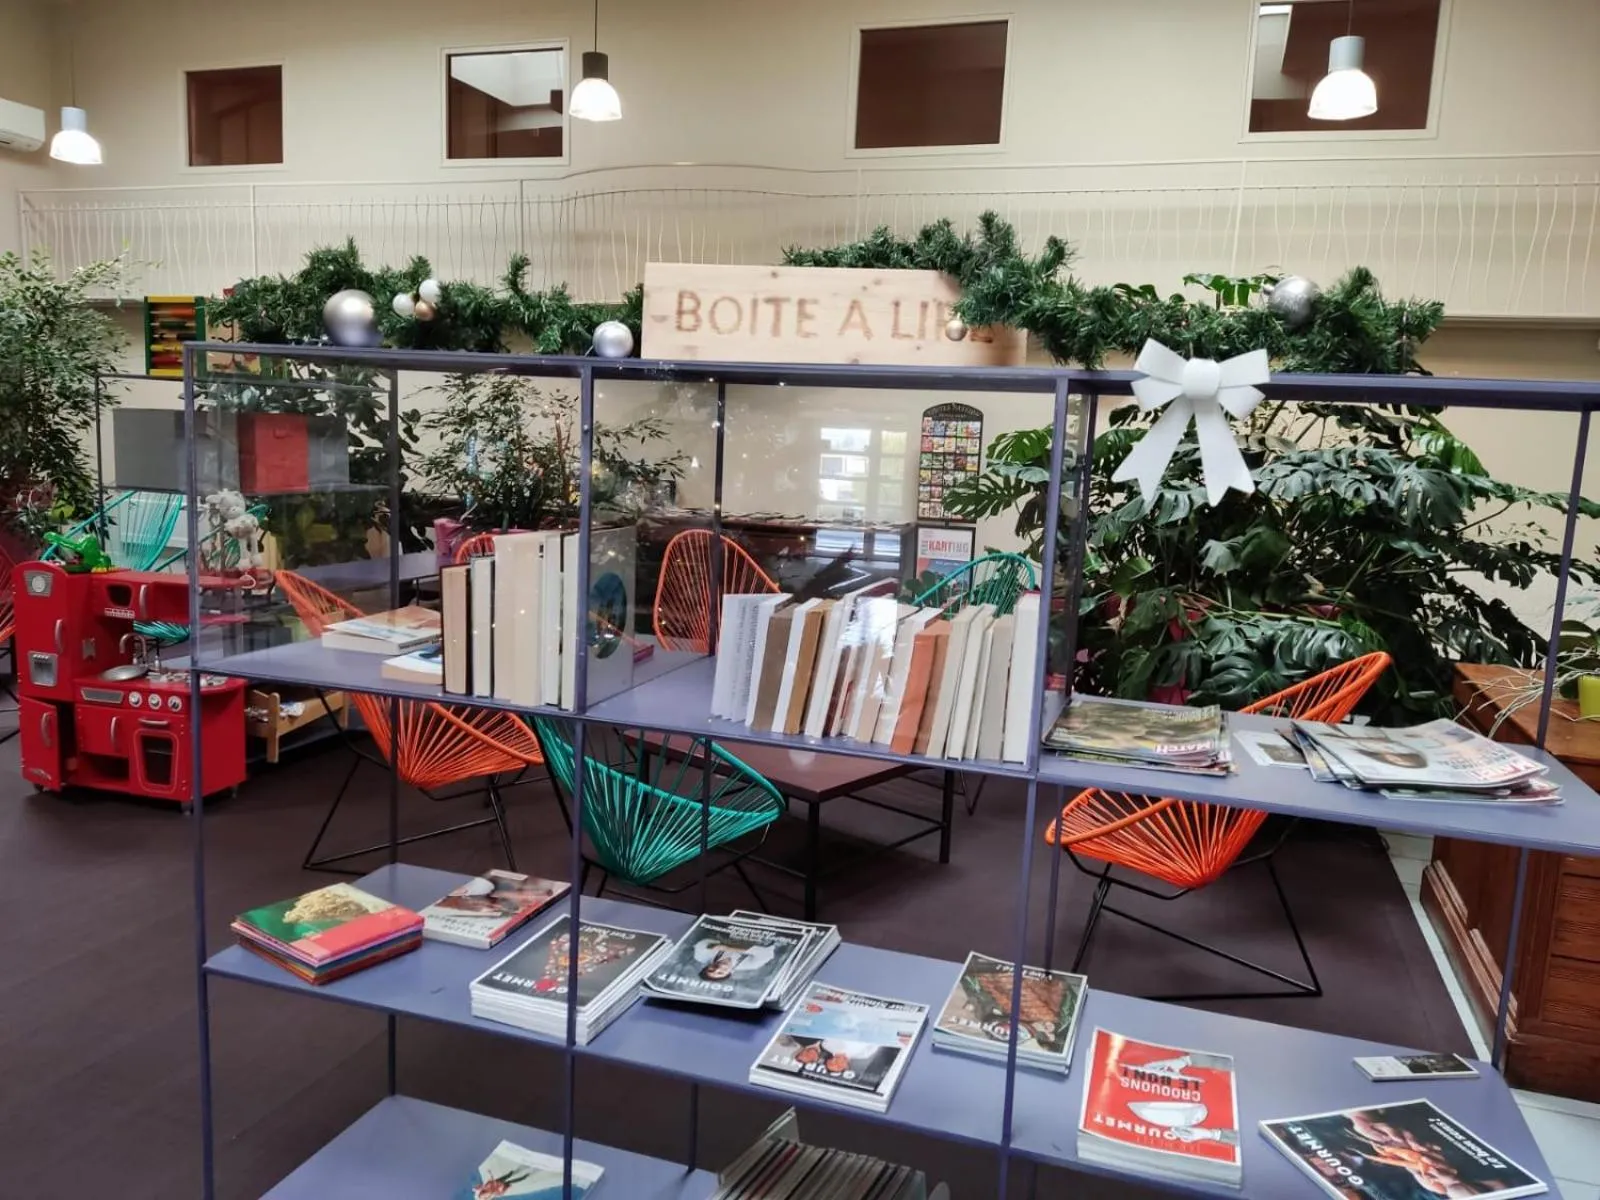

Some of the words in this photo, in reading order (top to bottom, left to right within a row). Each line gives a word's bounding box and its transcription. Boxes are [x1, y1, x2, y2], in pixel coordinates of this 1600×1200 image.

[674, 289, 820, 339] BOITE
[837, 298, 875, 341] A
[927, 539, 969, 553] KARTING
[1155, 741, 1213, 755] MATCH
[492, 972, 569, 994] GRMET
[656, 972, 735, 993] GOURMET
[1136, 1069, 1172, 1087] BON
[1178, 1080, 1201, 1092] LE
[1287, 1123, 1366, 1187] GOURMET
[1464, 1140, 1489, 1158] bon
